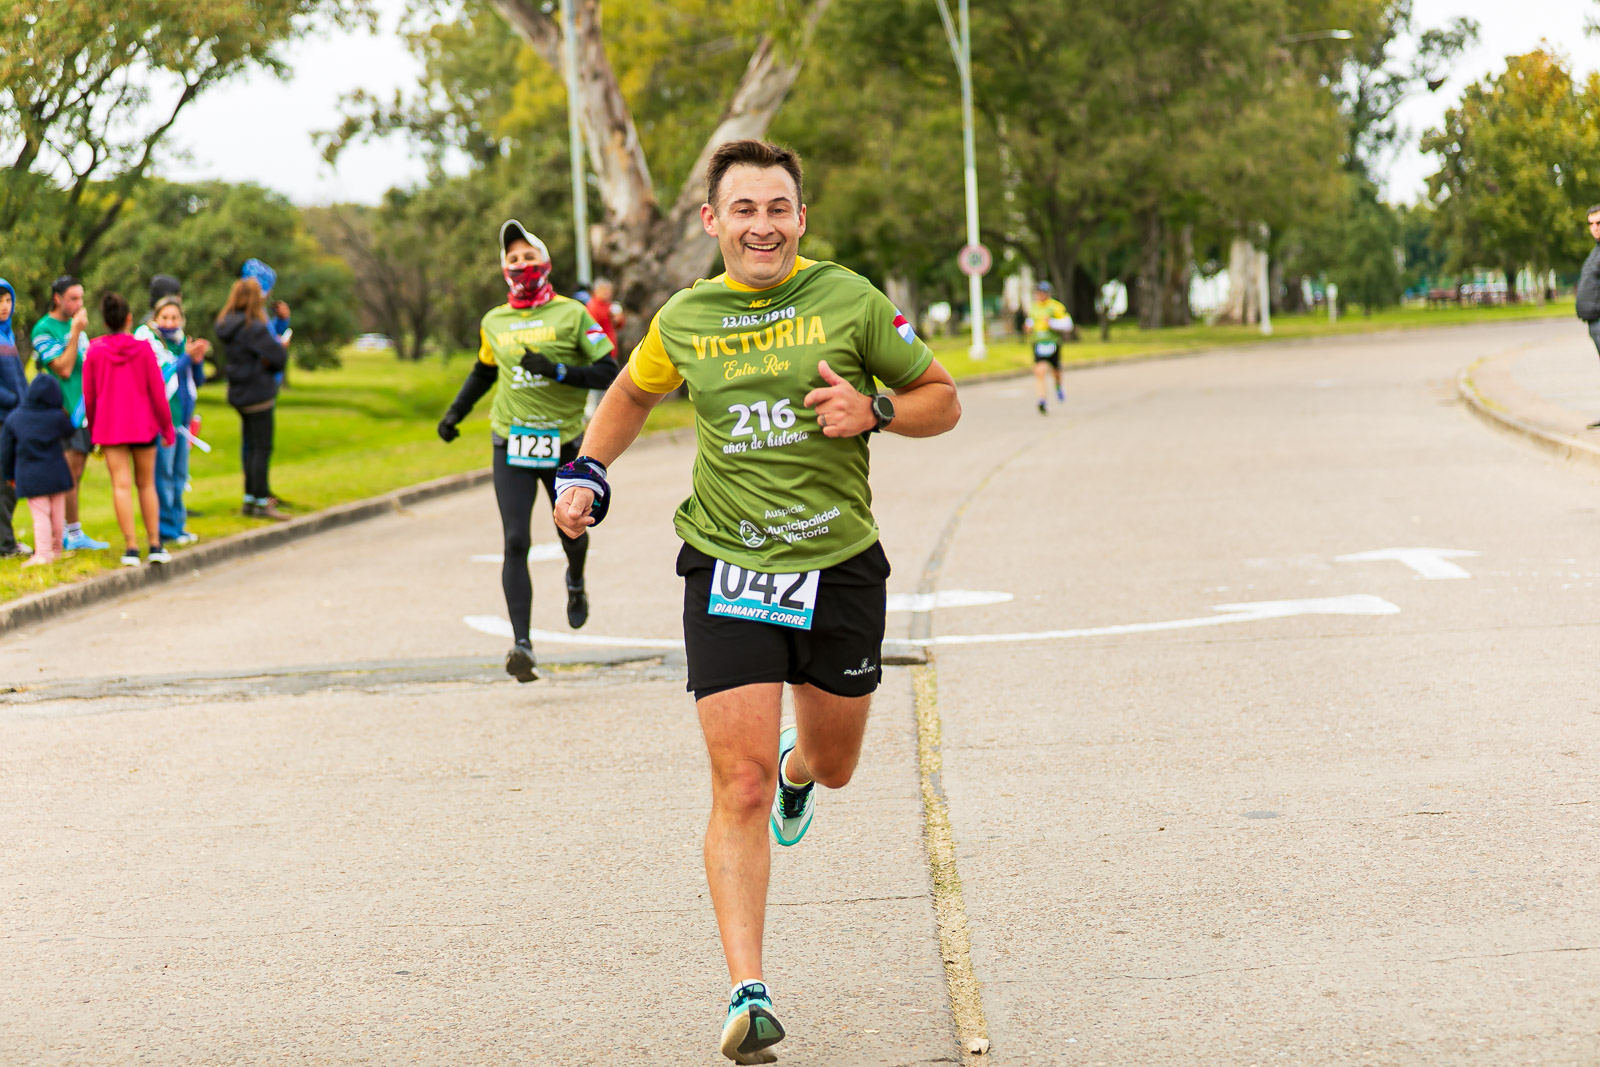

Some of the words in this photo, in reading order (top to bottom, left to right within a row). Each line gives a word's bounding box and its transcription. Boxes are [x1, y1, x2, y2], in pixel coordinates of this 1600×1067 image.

[692, 316, 826, 360] VICTORIA
[723, 359, 758, 380] Entre
[728, 398, 796, 437] 216
[515, 434, 553, 458] 123
[751, 434, 765, 450] de
[767, 430, 809, 447] historia
[763, 506, 841, 535] Municipalidad
[765, 504, 806, 519] Auspicia:
[783, 525, 829, 544] Victoria
[720, 563, 809, 611] 042
[714, 603, 769, 620] DIAMANTE
[770, 611, 807, 626] CORRE
